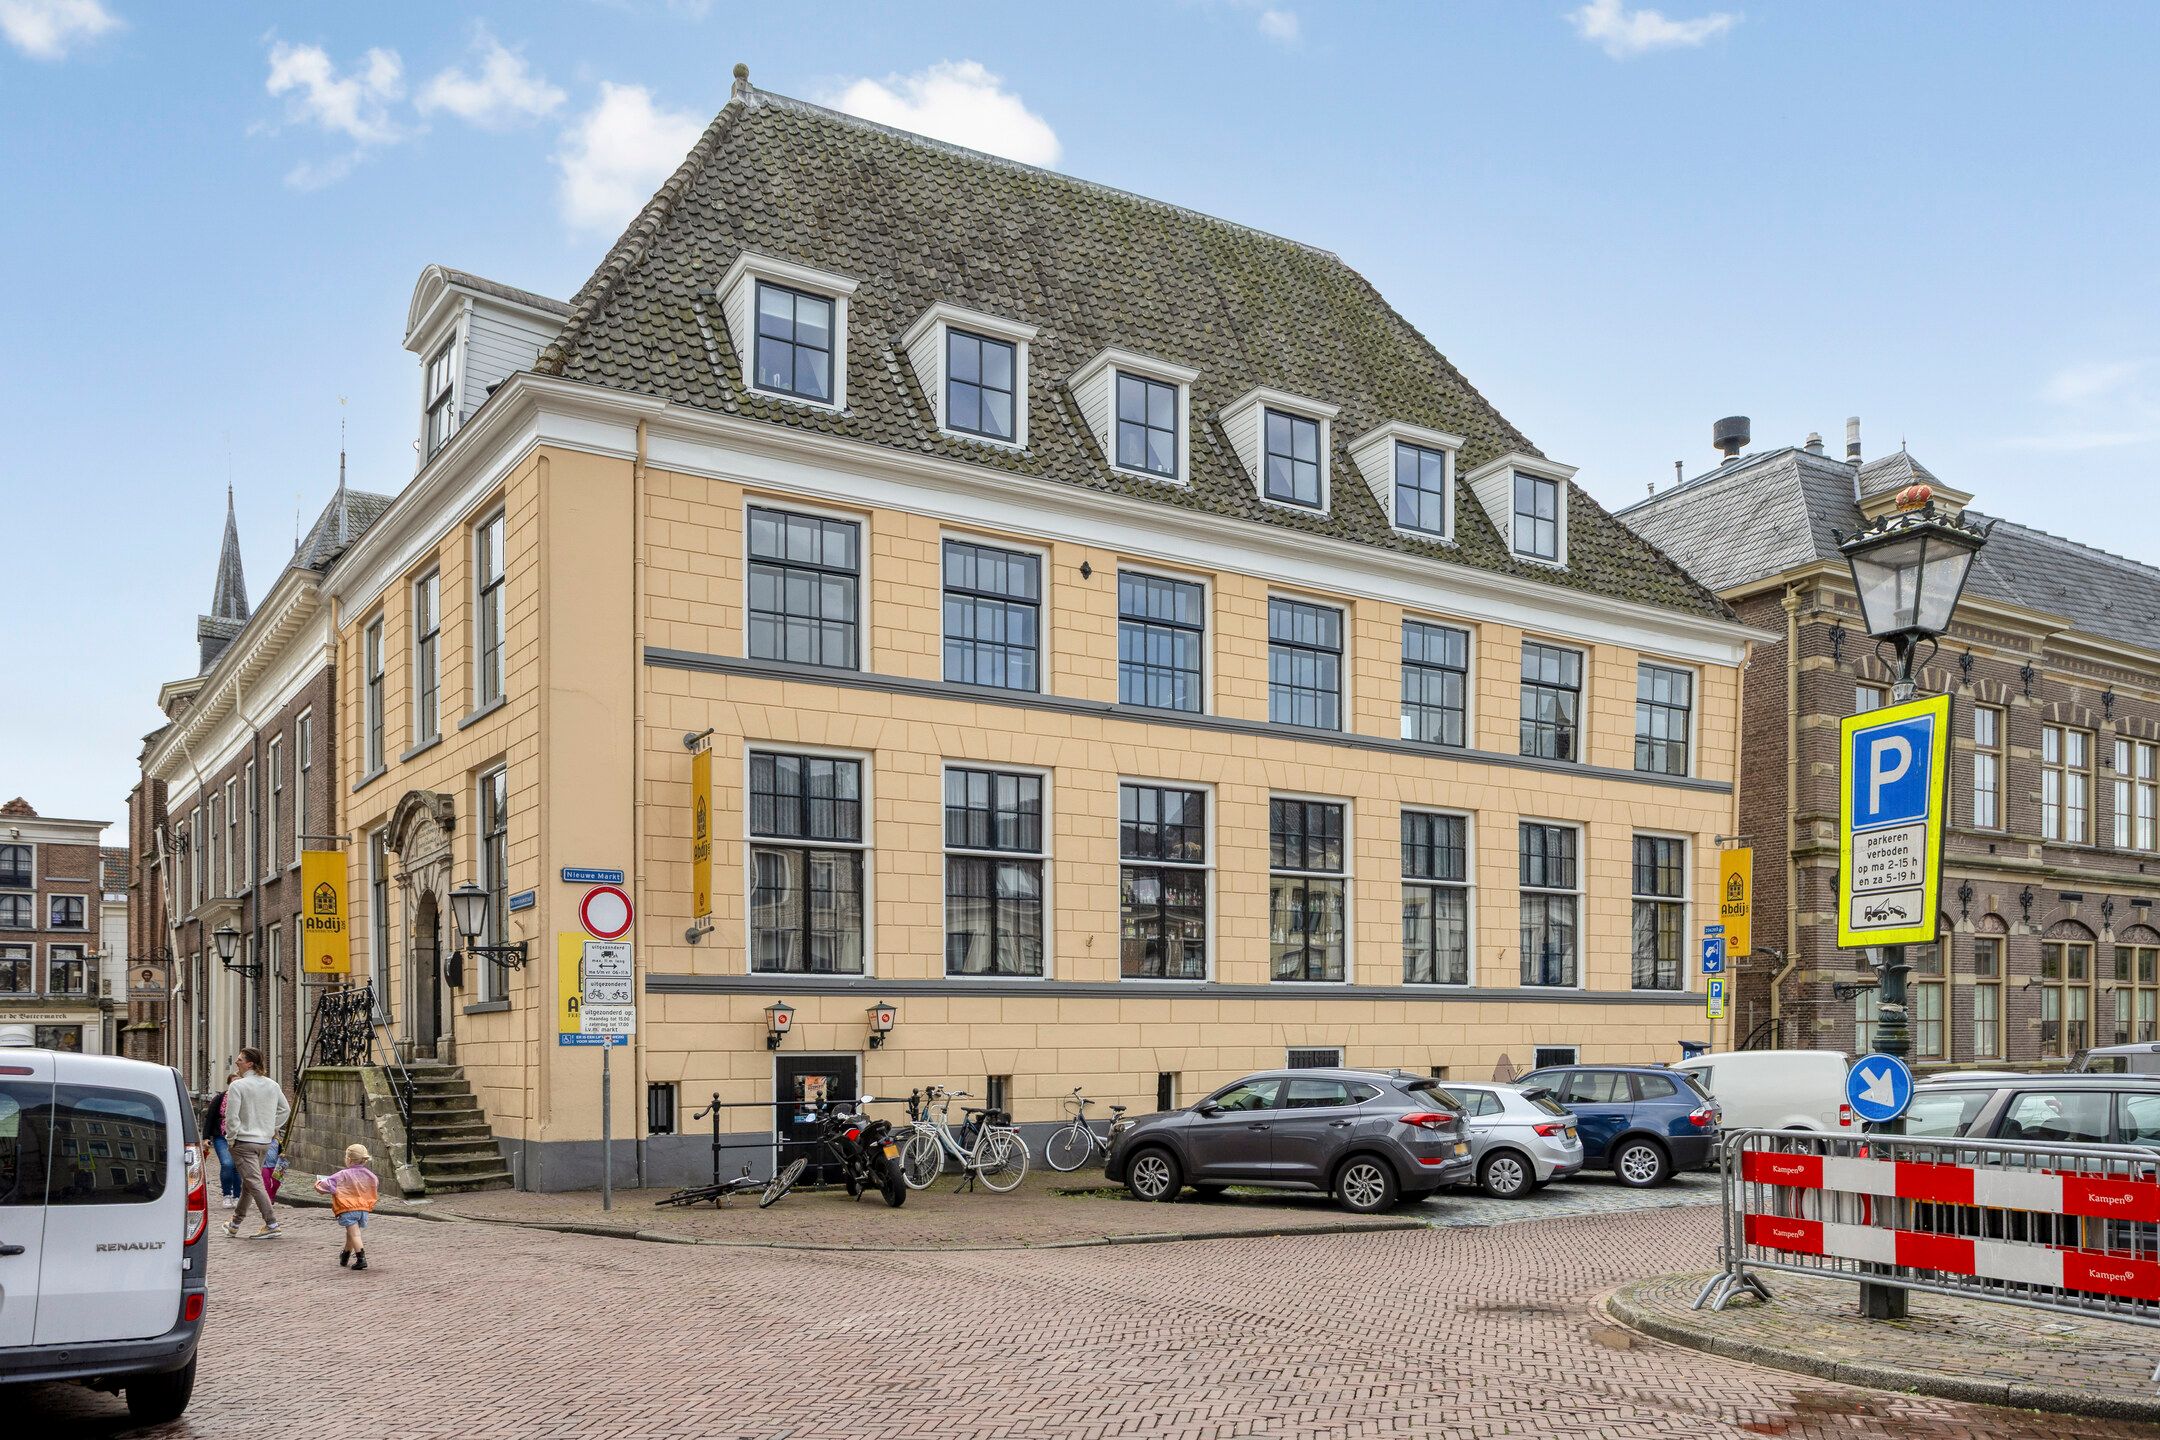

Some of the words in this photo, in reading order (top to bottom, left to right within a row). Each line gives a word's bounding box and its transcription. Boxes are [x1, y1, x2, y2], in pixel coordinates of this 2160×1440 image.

[1869, 735, 1912, 815] P
[1867, 833, 1908, 848] parkeren
[1867, 846, 1909, 859] verboden
[1858, 865, 1868, 875] op
[1871, 863, 1884, 872] ma
[1887, 857, 1908, 870] 2-15
[1912, 857, 1918, 866] h
[566, 871, 595, 879] Nieuwe
[597, 872, 620, 880] Markt
[1859, 878, 1869, 886] en
[1886, 871, 1907, 883] 5-19
[1910, 871, 1916, 880] h
[1721, 902, 1745, 916] Abdij
[306, 917, 341, 933] Abdij
[1712, 983, 1720, 997] P
[96, 1241, 166, 1252] RENAULT
